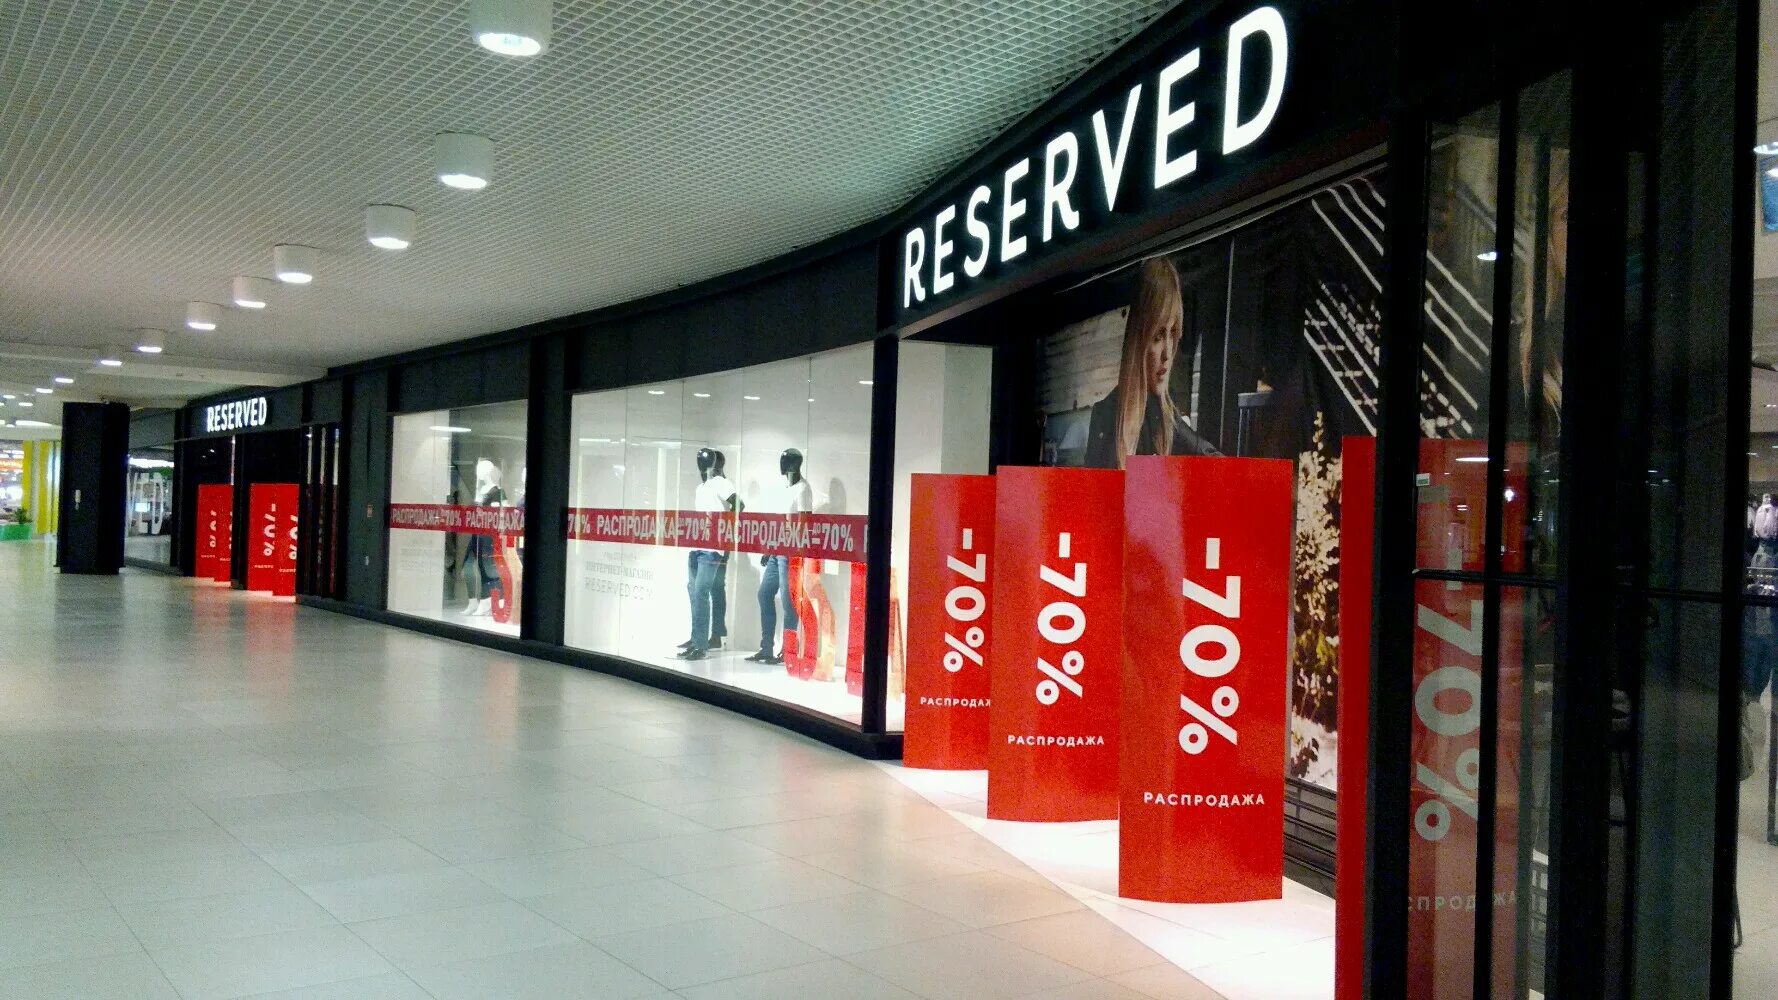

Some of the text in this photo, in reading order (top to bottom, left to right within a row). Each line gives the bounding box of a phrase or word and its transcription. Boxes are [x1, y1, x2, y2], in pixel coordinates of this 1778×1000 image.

[903, 5, 1289, 308] RESERVED
[206, 396, 268, 433] RESERVED
[597, 514, 677, 540] РАСПРОДАЖА
[718, 518, 810, 550] РАСПРОДАЖА
[942, 527, 986, 673] -70%
[1035, 532, 1087, 706] -70%
[1178, 537, 1241, 755] -70%
[920, 696, 991, 708] РАСПРОДАЖ
[1007, 734, 1105, 748] РАСПРОДАЖА
[1143, 791, 1265, 808] РАСПРОДАЖА
